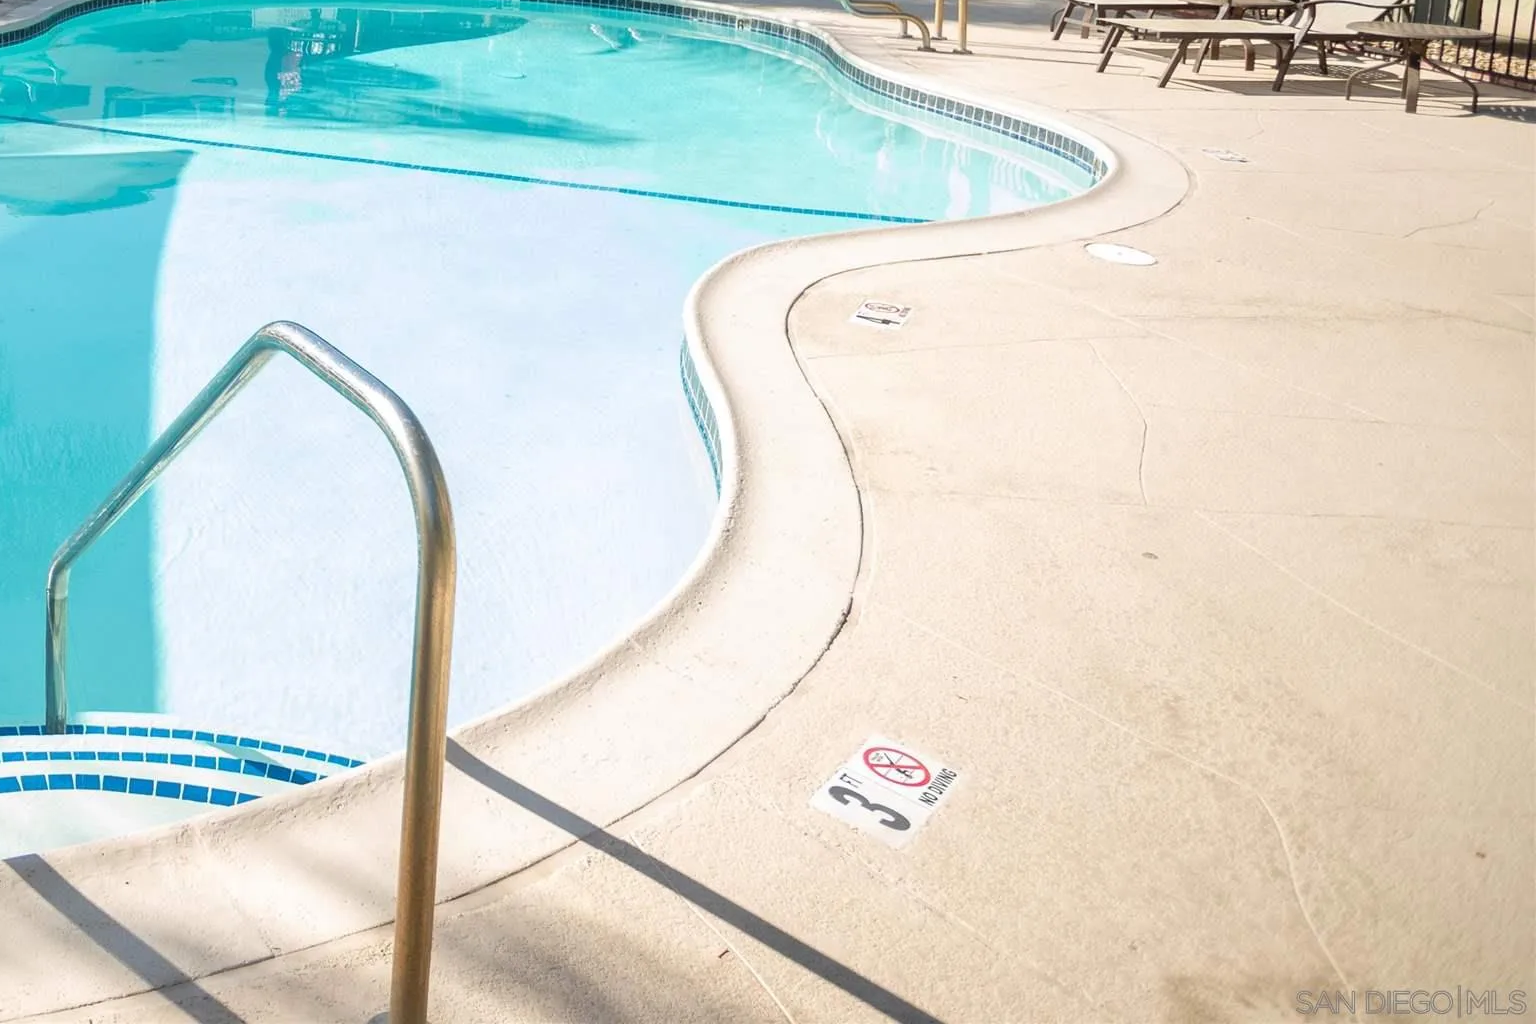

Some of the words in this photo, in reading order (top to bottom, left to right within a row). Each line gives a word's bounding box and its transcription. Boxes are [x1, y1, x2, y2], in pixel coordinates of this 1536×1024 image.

[928, 767, 958, 796] DIVING
[828, 785, 911, 831] 3
[918, 791, 939, 807] NO
